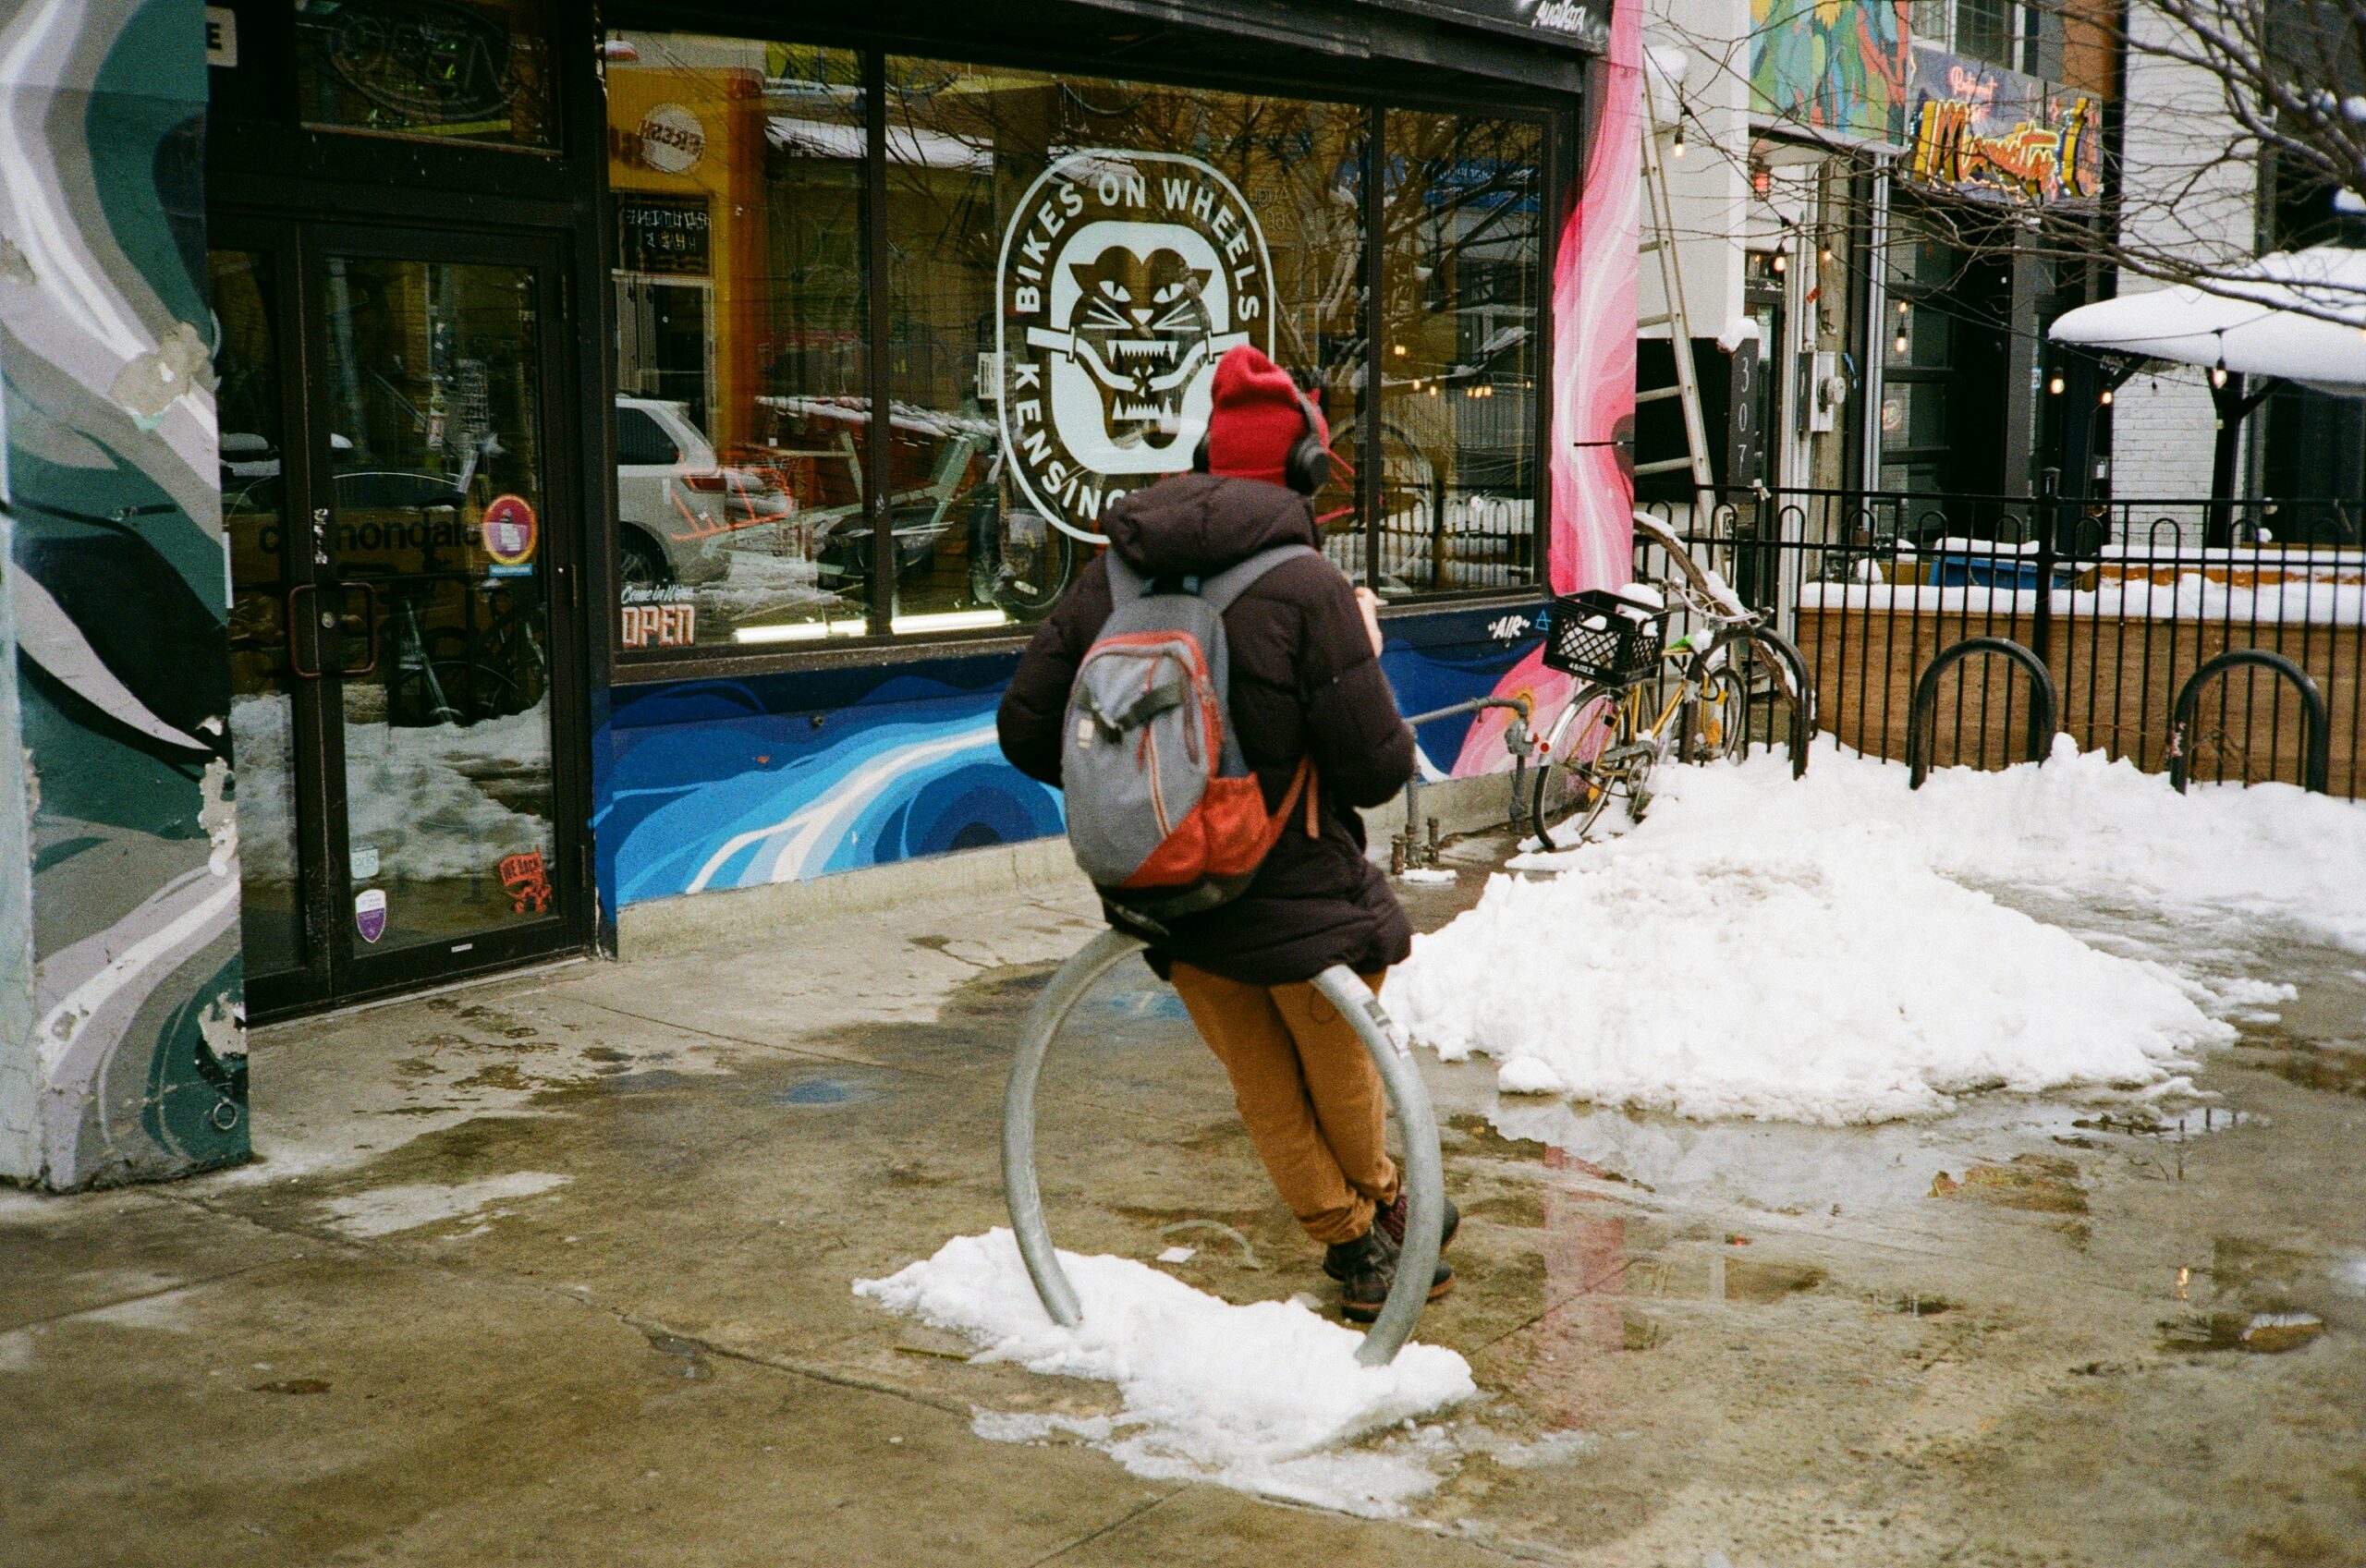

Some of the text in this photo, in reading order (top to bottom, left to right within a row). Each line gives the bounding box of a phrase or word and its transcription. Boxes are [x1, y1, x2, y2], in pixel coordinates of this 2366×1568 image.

[1015, 175, 1260, 322] BIKES ON WHEELS
[1737, 357, 1750, 478] 307
[620, 585, 652, 604] Come
[621, 604, 695, 649] OPEN
